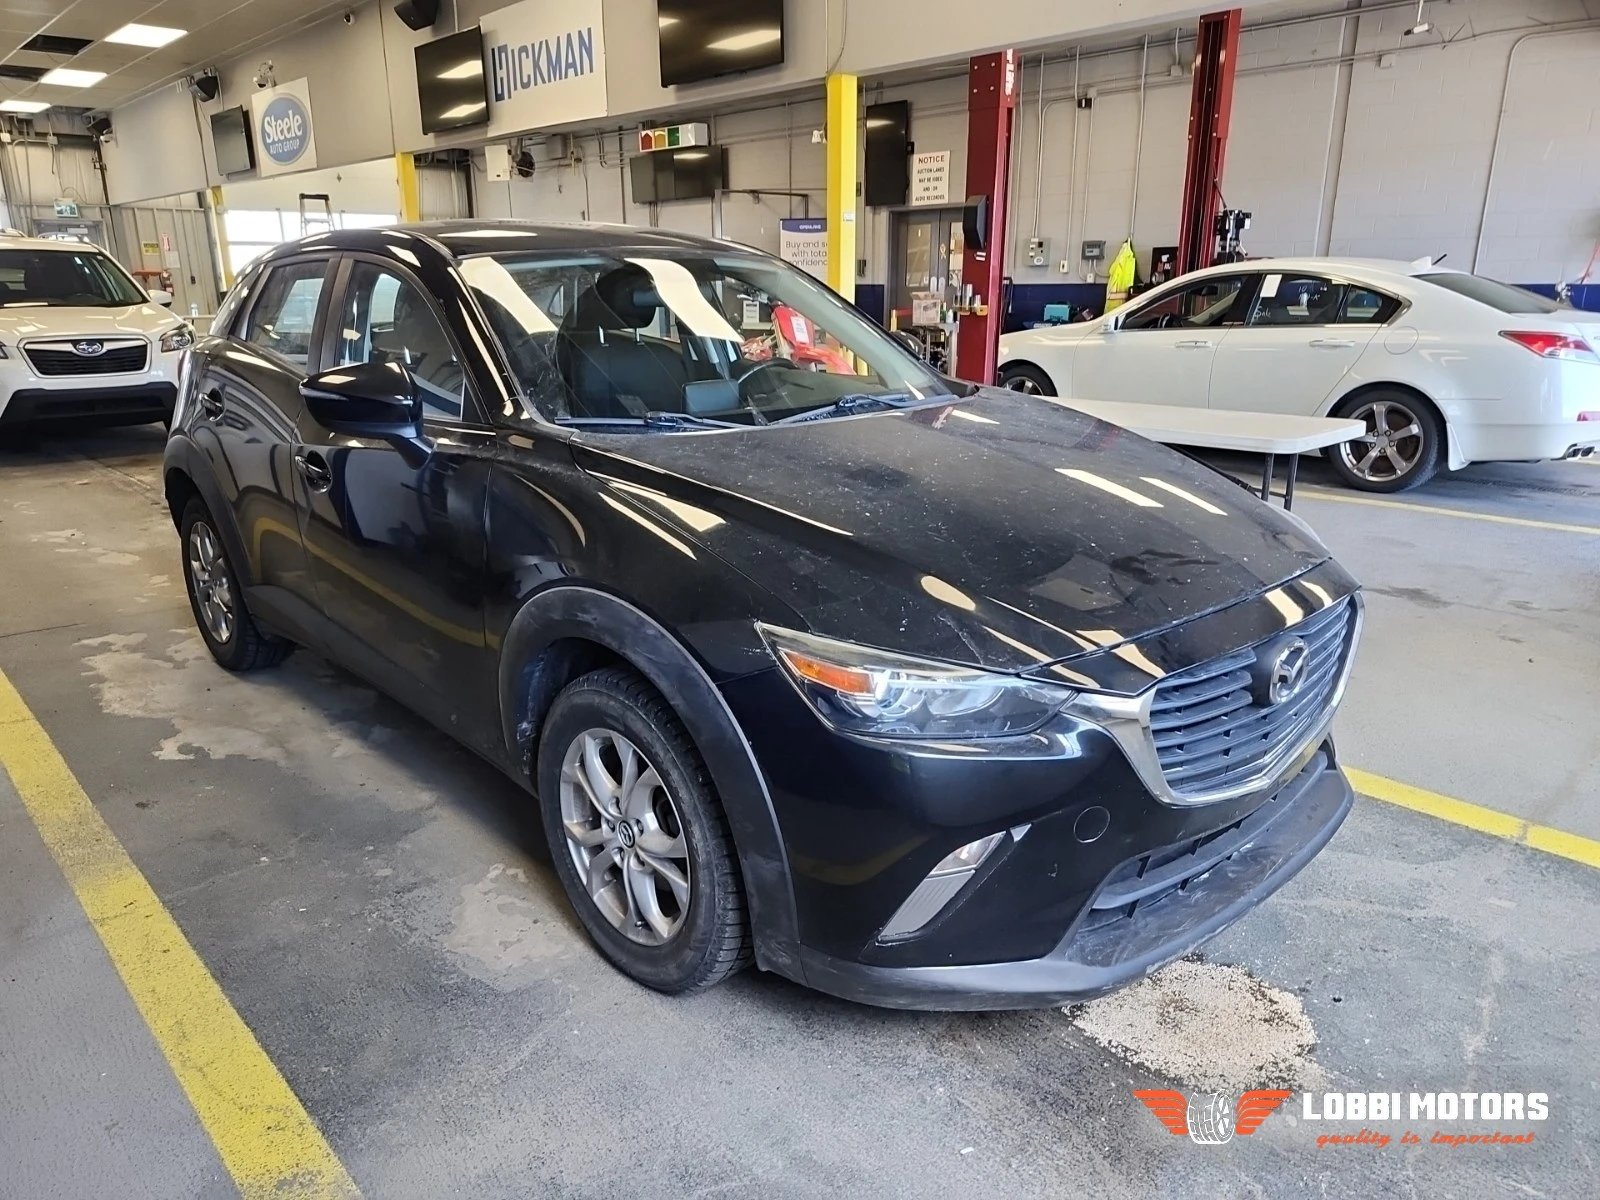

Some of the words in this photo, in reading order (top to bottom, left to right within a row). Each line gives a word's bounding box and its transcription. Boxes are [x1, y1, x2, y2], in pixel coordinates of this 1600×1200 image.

[264, 109, 303, 144] Steele
[270, 143, 283, 155] AUTO
[283, 139, 300, 152] GROUP
[918, 155, 945, 165] NOTICE
[785, 241, 801, 250] Buy
[803, 241, 820, 249] and
[791, 250, 809, 258] with
